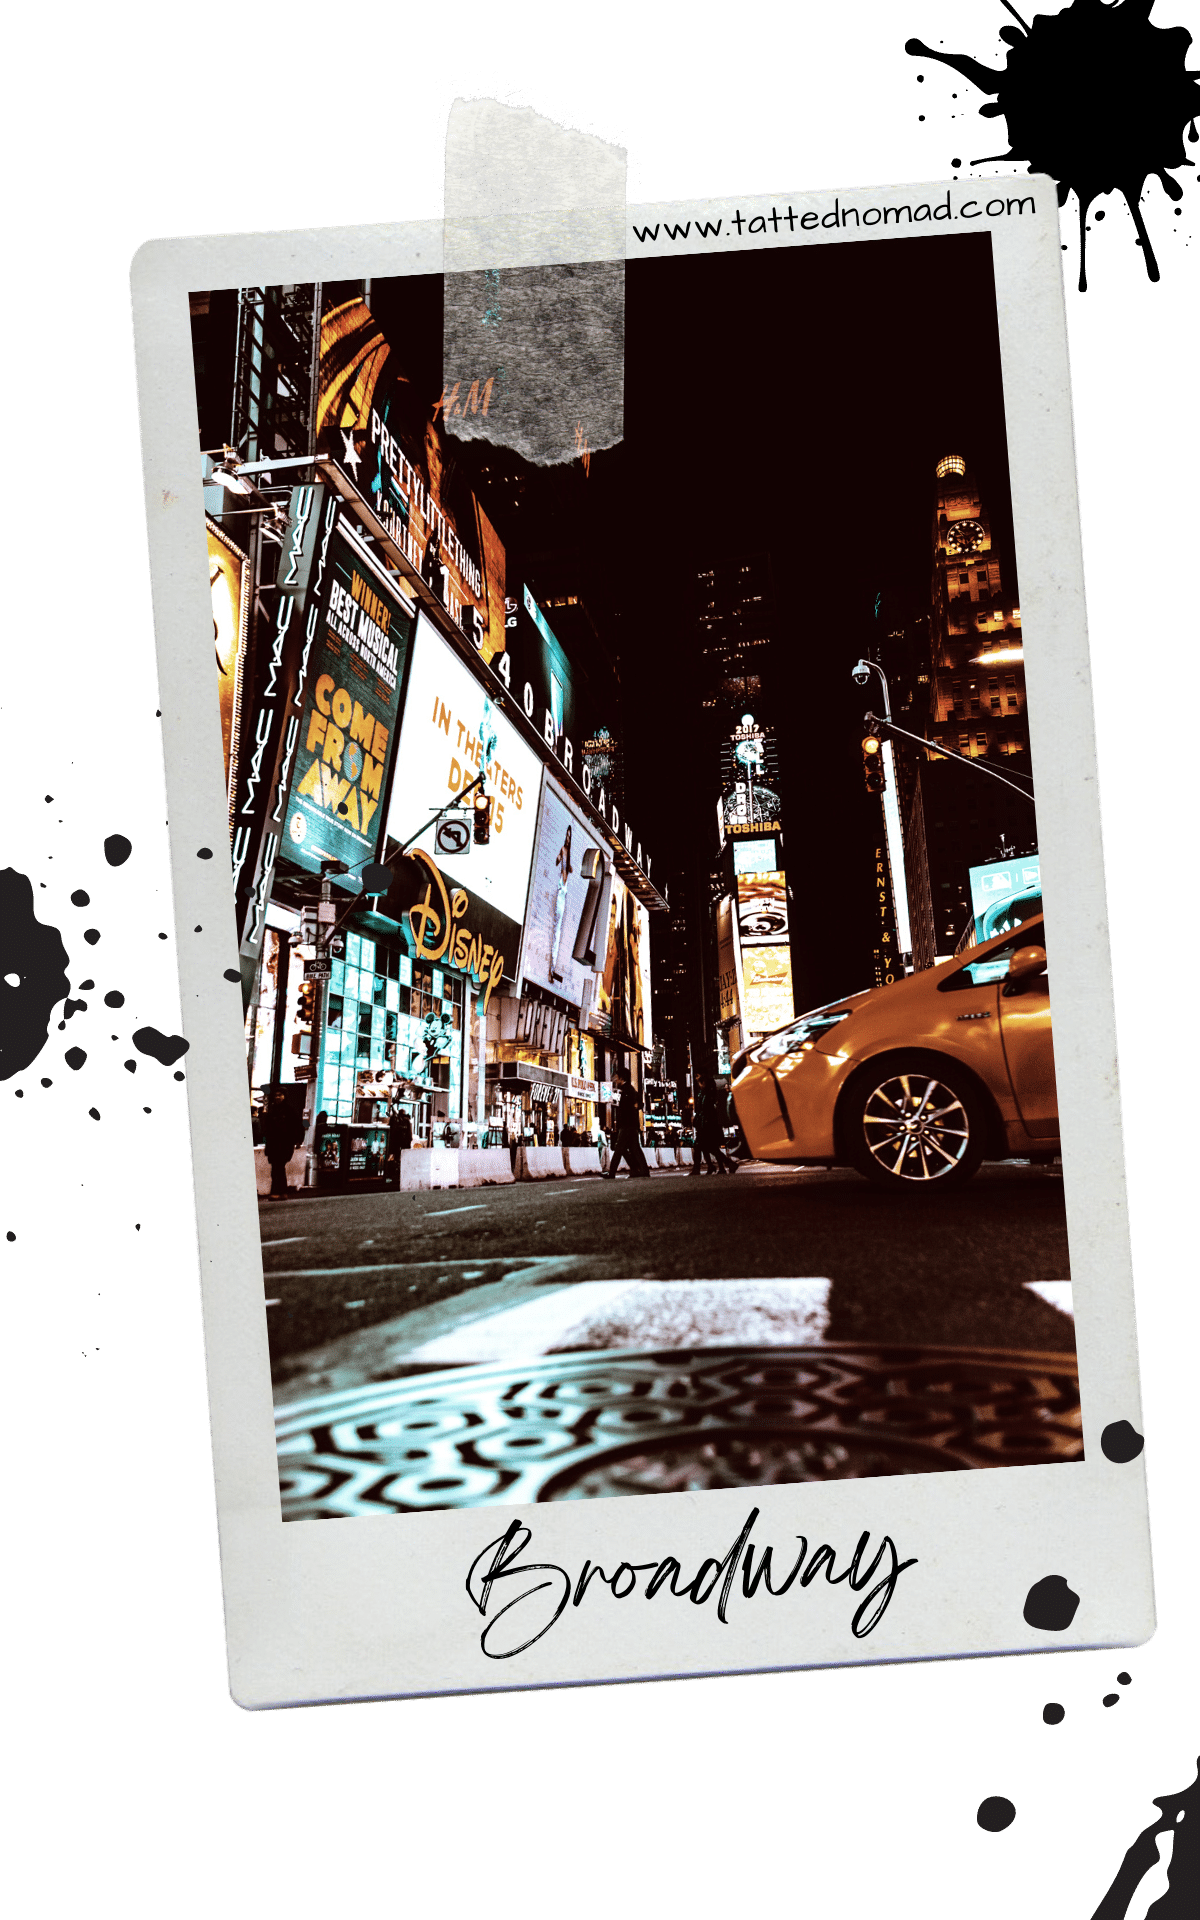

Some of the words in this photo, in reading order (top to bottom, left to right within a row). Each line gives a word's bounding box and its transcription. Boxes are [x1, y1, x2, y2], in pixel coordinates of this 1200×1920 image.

[432, 377, 495, 422] H&M
[351, 569, 391, 635] WINNER!
[326, 609, 337, 631] ALL
[338, 620, 360, 652] ACROSS
[329, 579, 359, 630] BEST
[358, 610, 399, 676] MUSICAL
[315, 673, 389, 764] COME
[432, 696, 452, 736] IN
[730, 732, 765, 741] TOSHIBA
[735, 724, 760, 735] 2017
[297, 758, 378, 836] AWAY
[725, 821, 781, 834] TOSHIBA
[875, 848, 887, 917] ERNST
